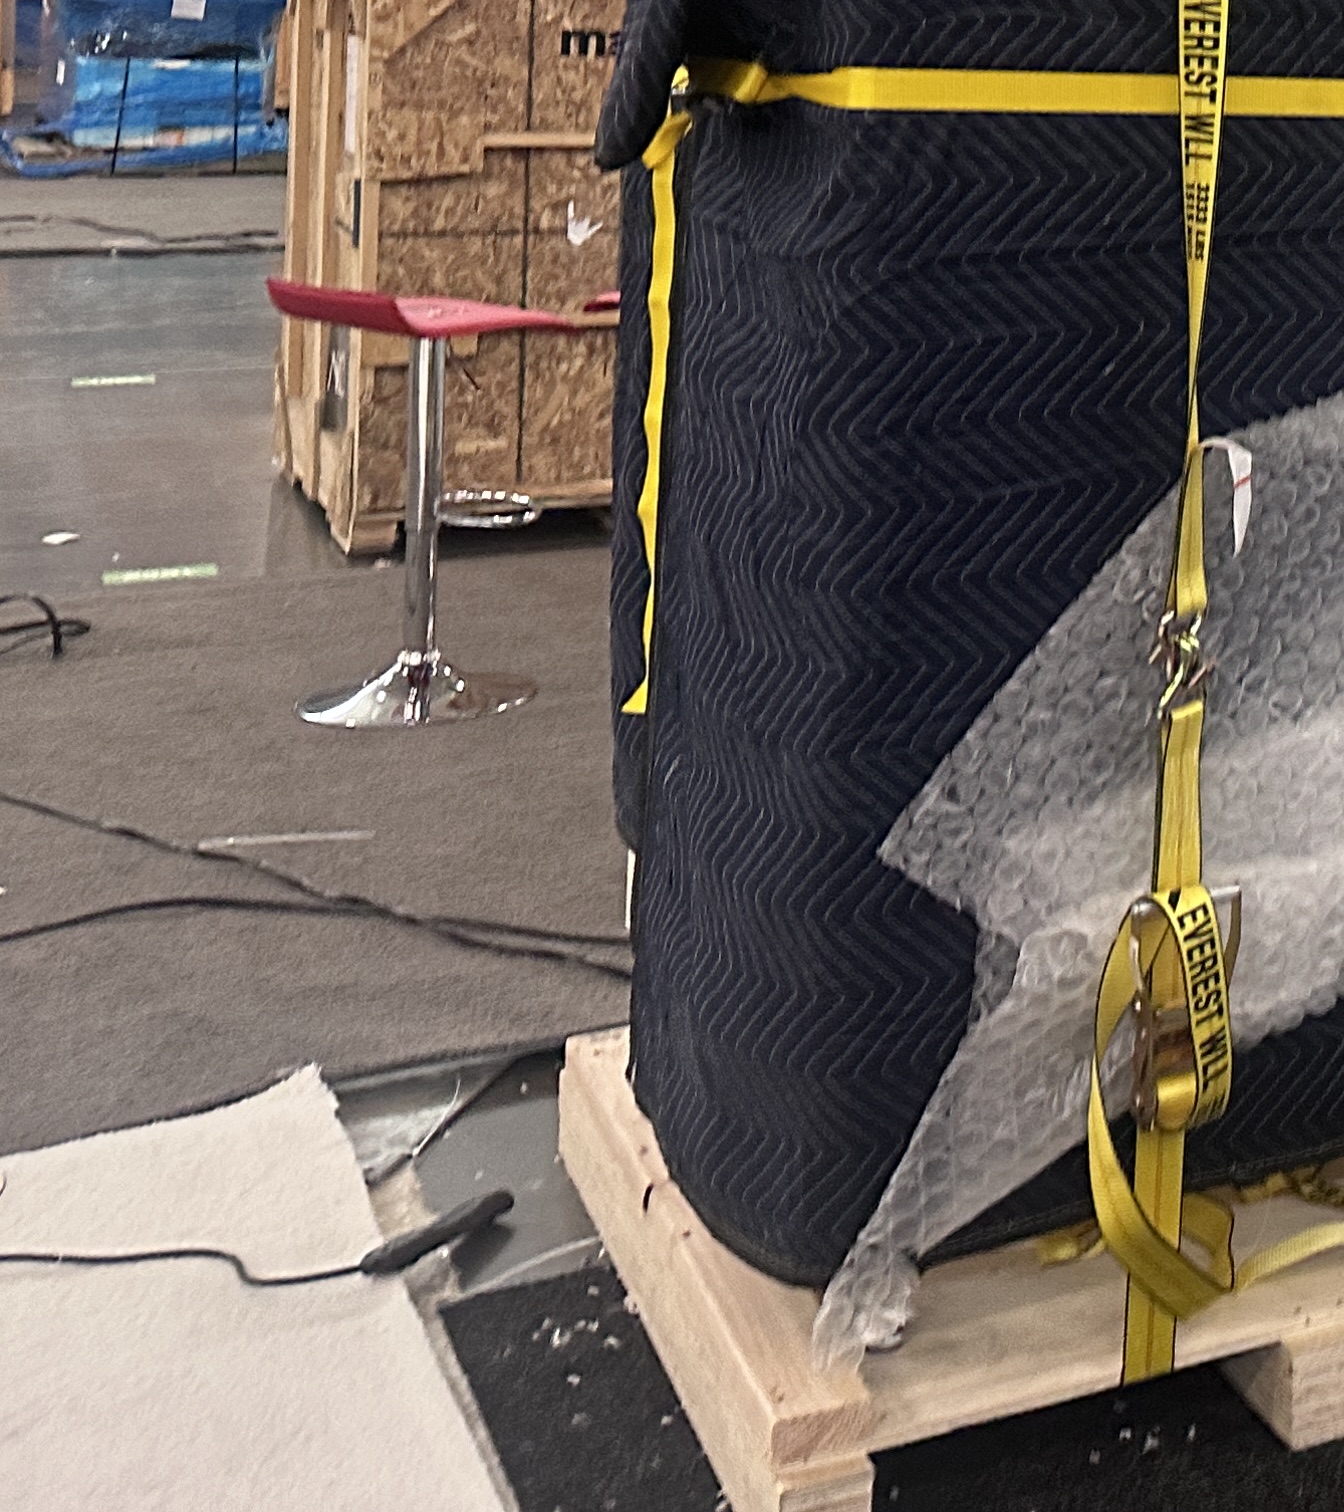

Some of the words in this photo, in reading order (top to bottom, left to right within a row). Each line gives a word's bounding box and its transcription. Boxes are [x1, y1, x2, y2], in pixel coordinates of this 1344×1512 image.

[1184, 113, 1215, 166] WLL
[1177, 902, 1225, 1028] EVEREST
[1199, 1025, 1229, 1094] WLL
